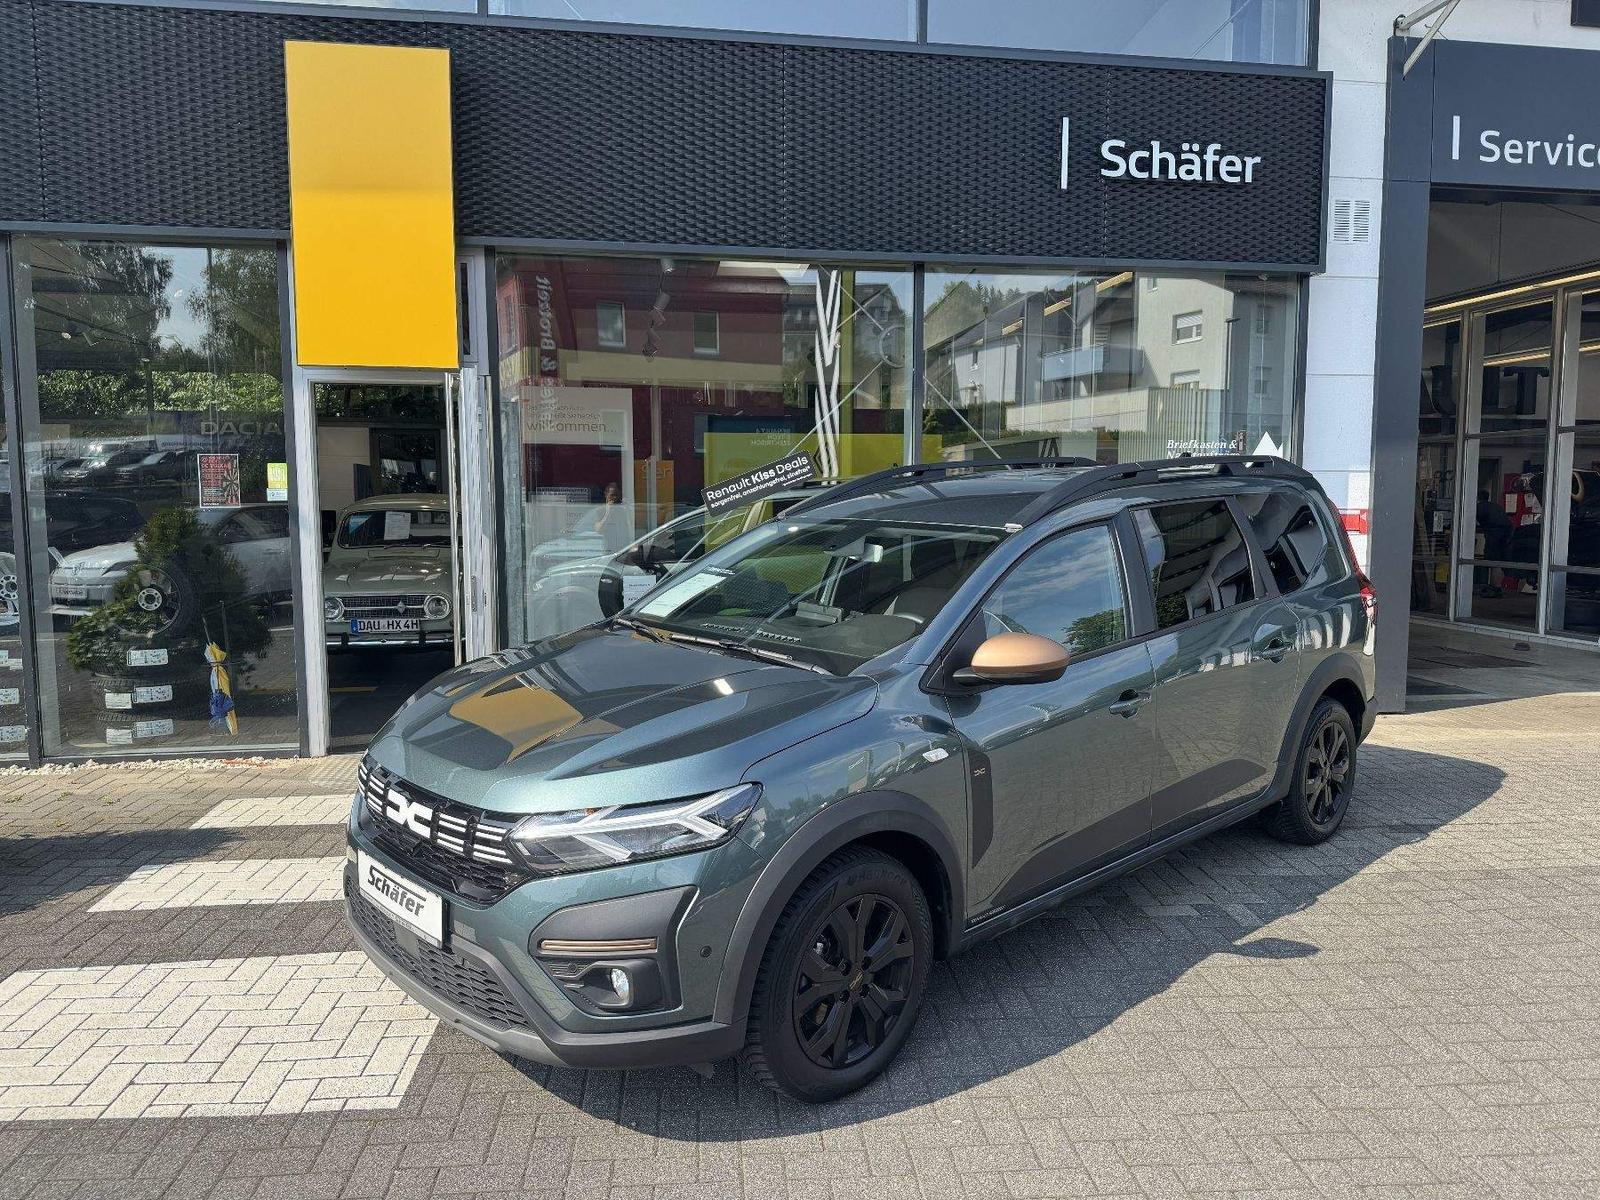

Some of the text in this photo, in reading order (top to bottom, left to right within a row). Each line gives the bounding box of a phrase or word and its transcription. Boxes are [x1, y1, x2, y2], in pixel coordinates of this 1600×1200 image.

[1100, 139, 1262, 184] Schäfer
[1479, 130, 1600, 168] Servic
[200, 421, 282, 435] DACIA
[1166, 439, 1238, 449] Briefkasten &
[706, 478, 752, 501] Renault
[775, 455, 809, 475] Deals
[358, 620, 381, 631] DAU
[387, 619, 402, 630] HX
[366, 864, 427, 917] Schäfer
